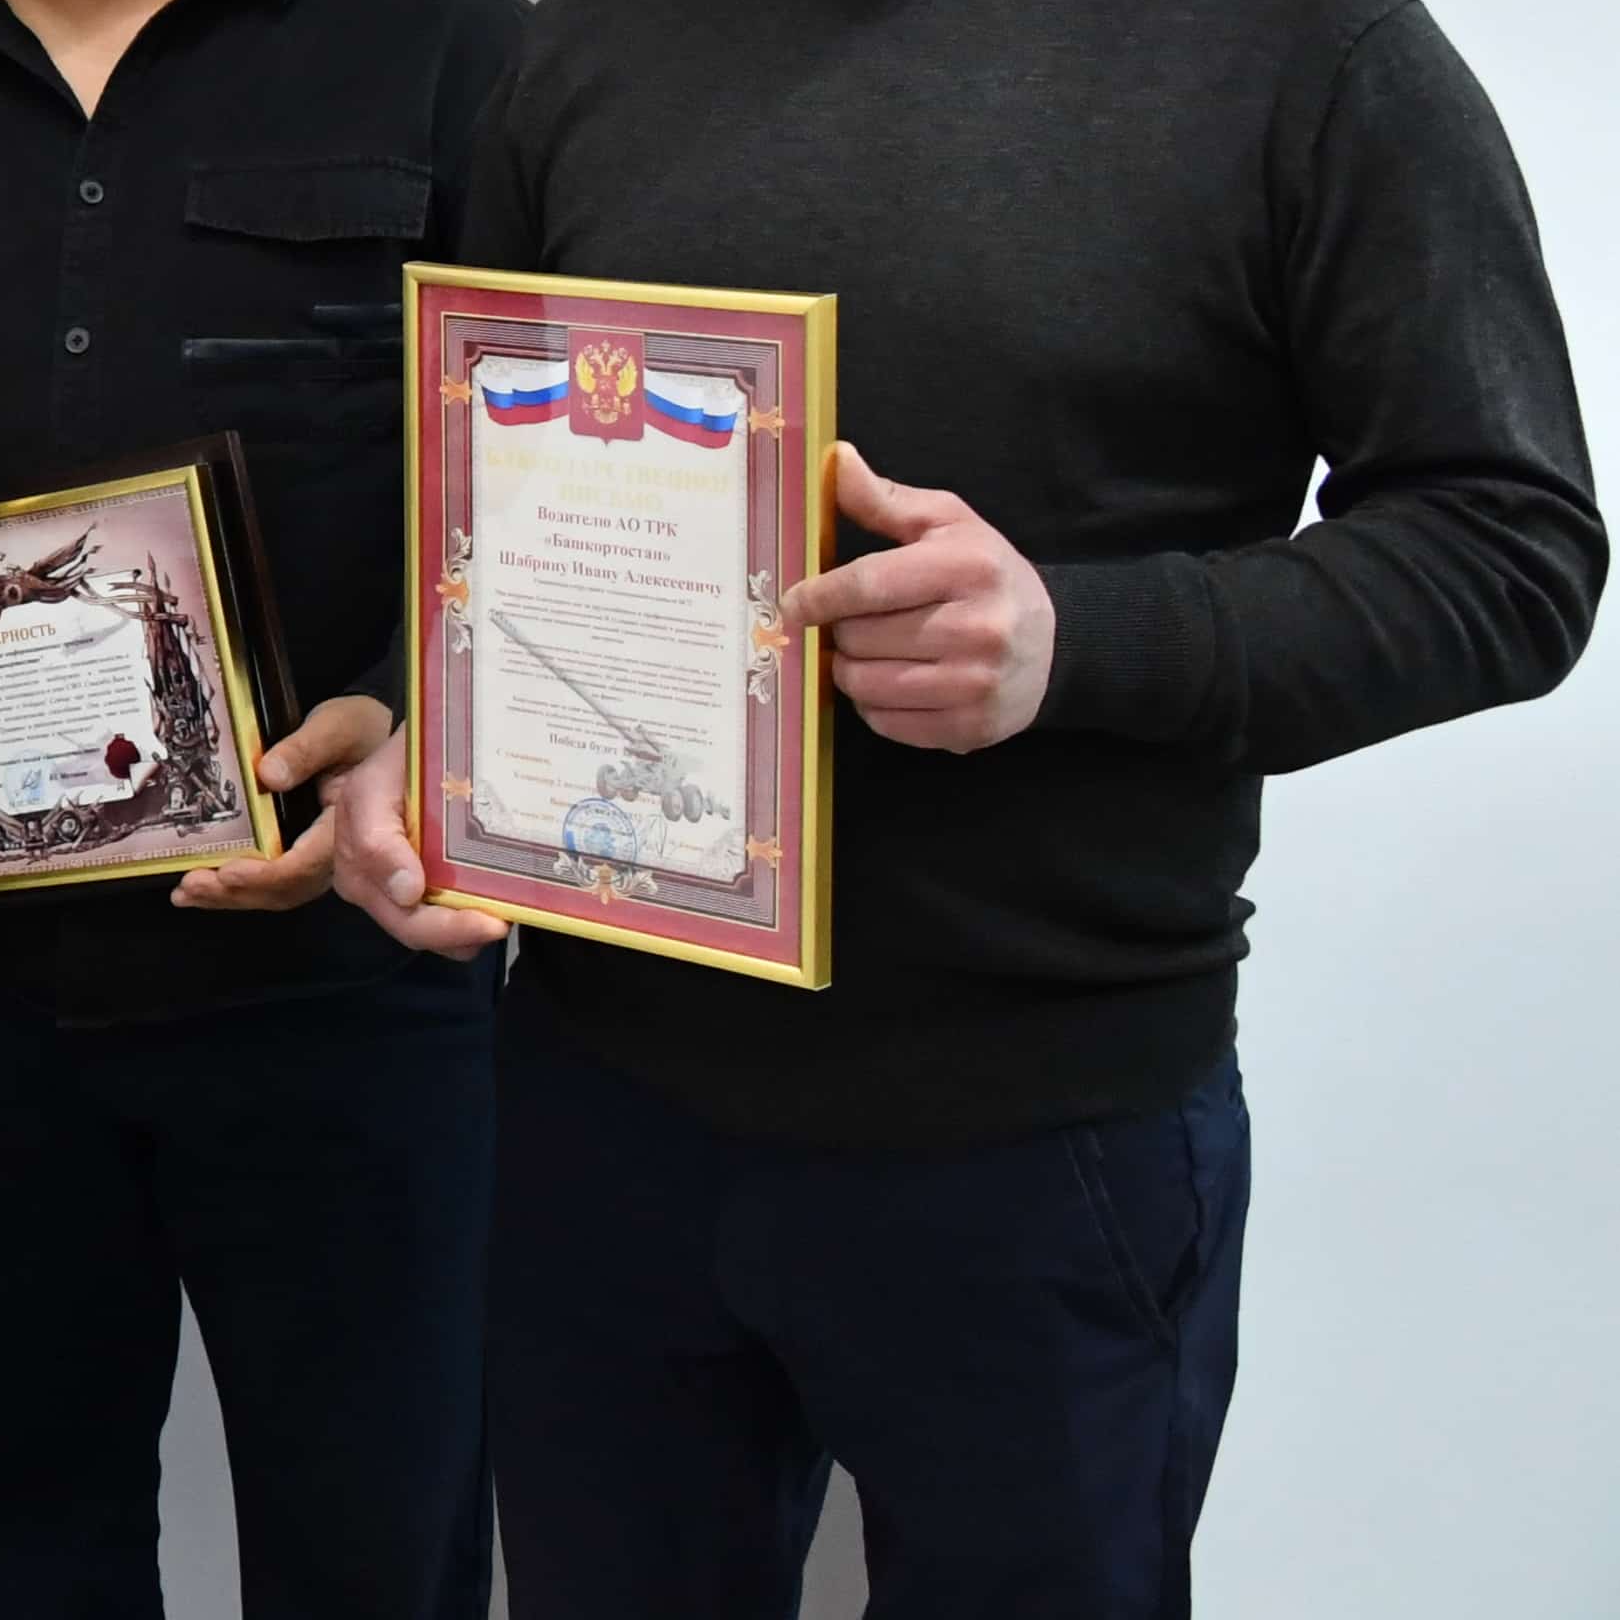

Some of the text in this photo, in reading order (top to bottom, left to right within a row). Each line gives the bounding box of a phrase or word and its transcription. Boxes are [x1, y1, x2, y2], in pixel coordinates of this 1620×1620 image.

[536, 506, 679, 537] Водителю АО ТРК
[543, 531, 671, 563] «Башкортостан»
[571, 561, 618, 582] Ивану
[624, 569, 723, 597] Алексеевичу
